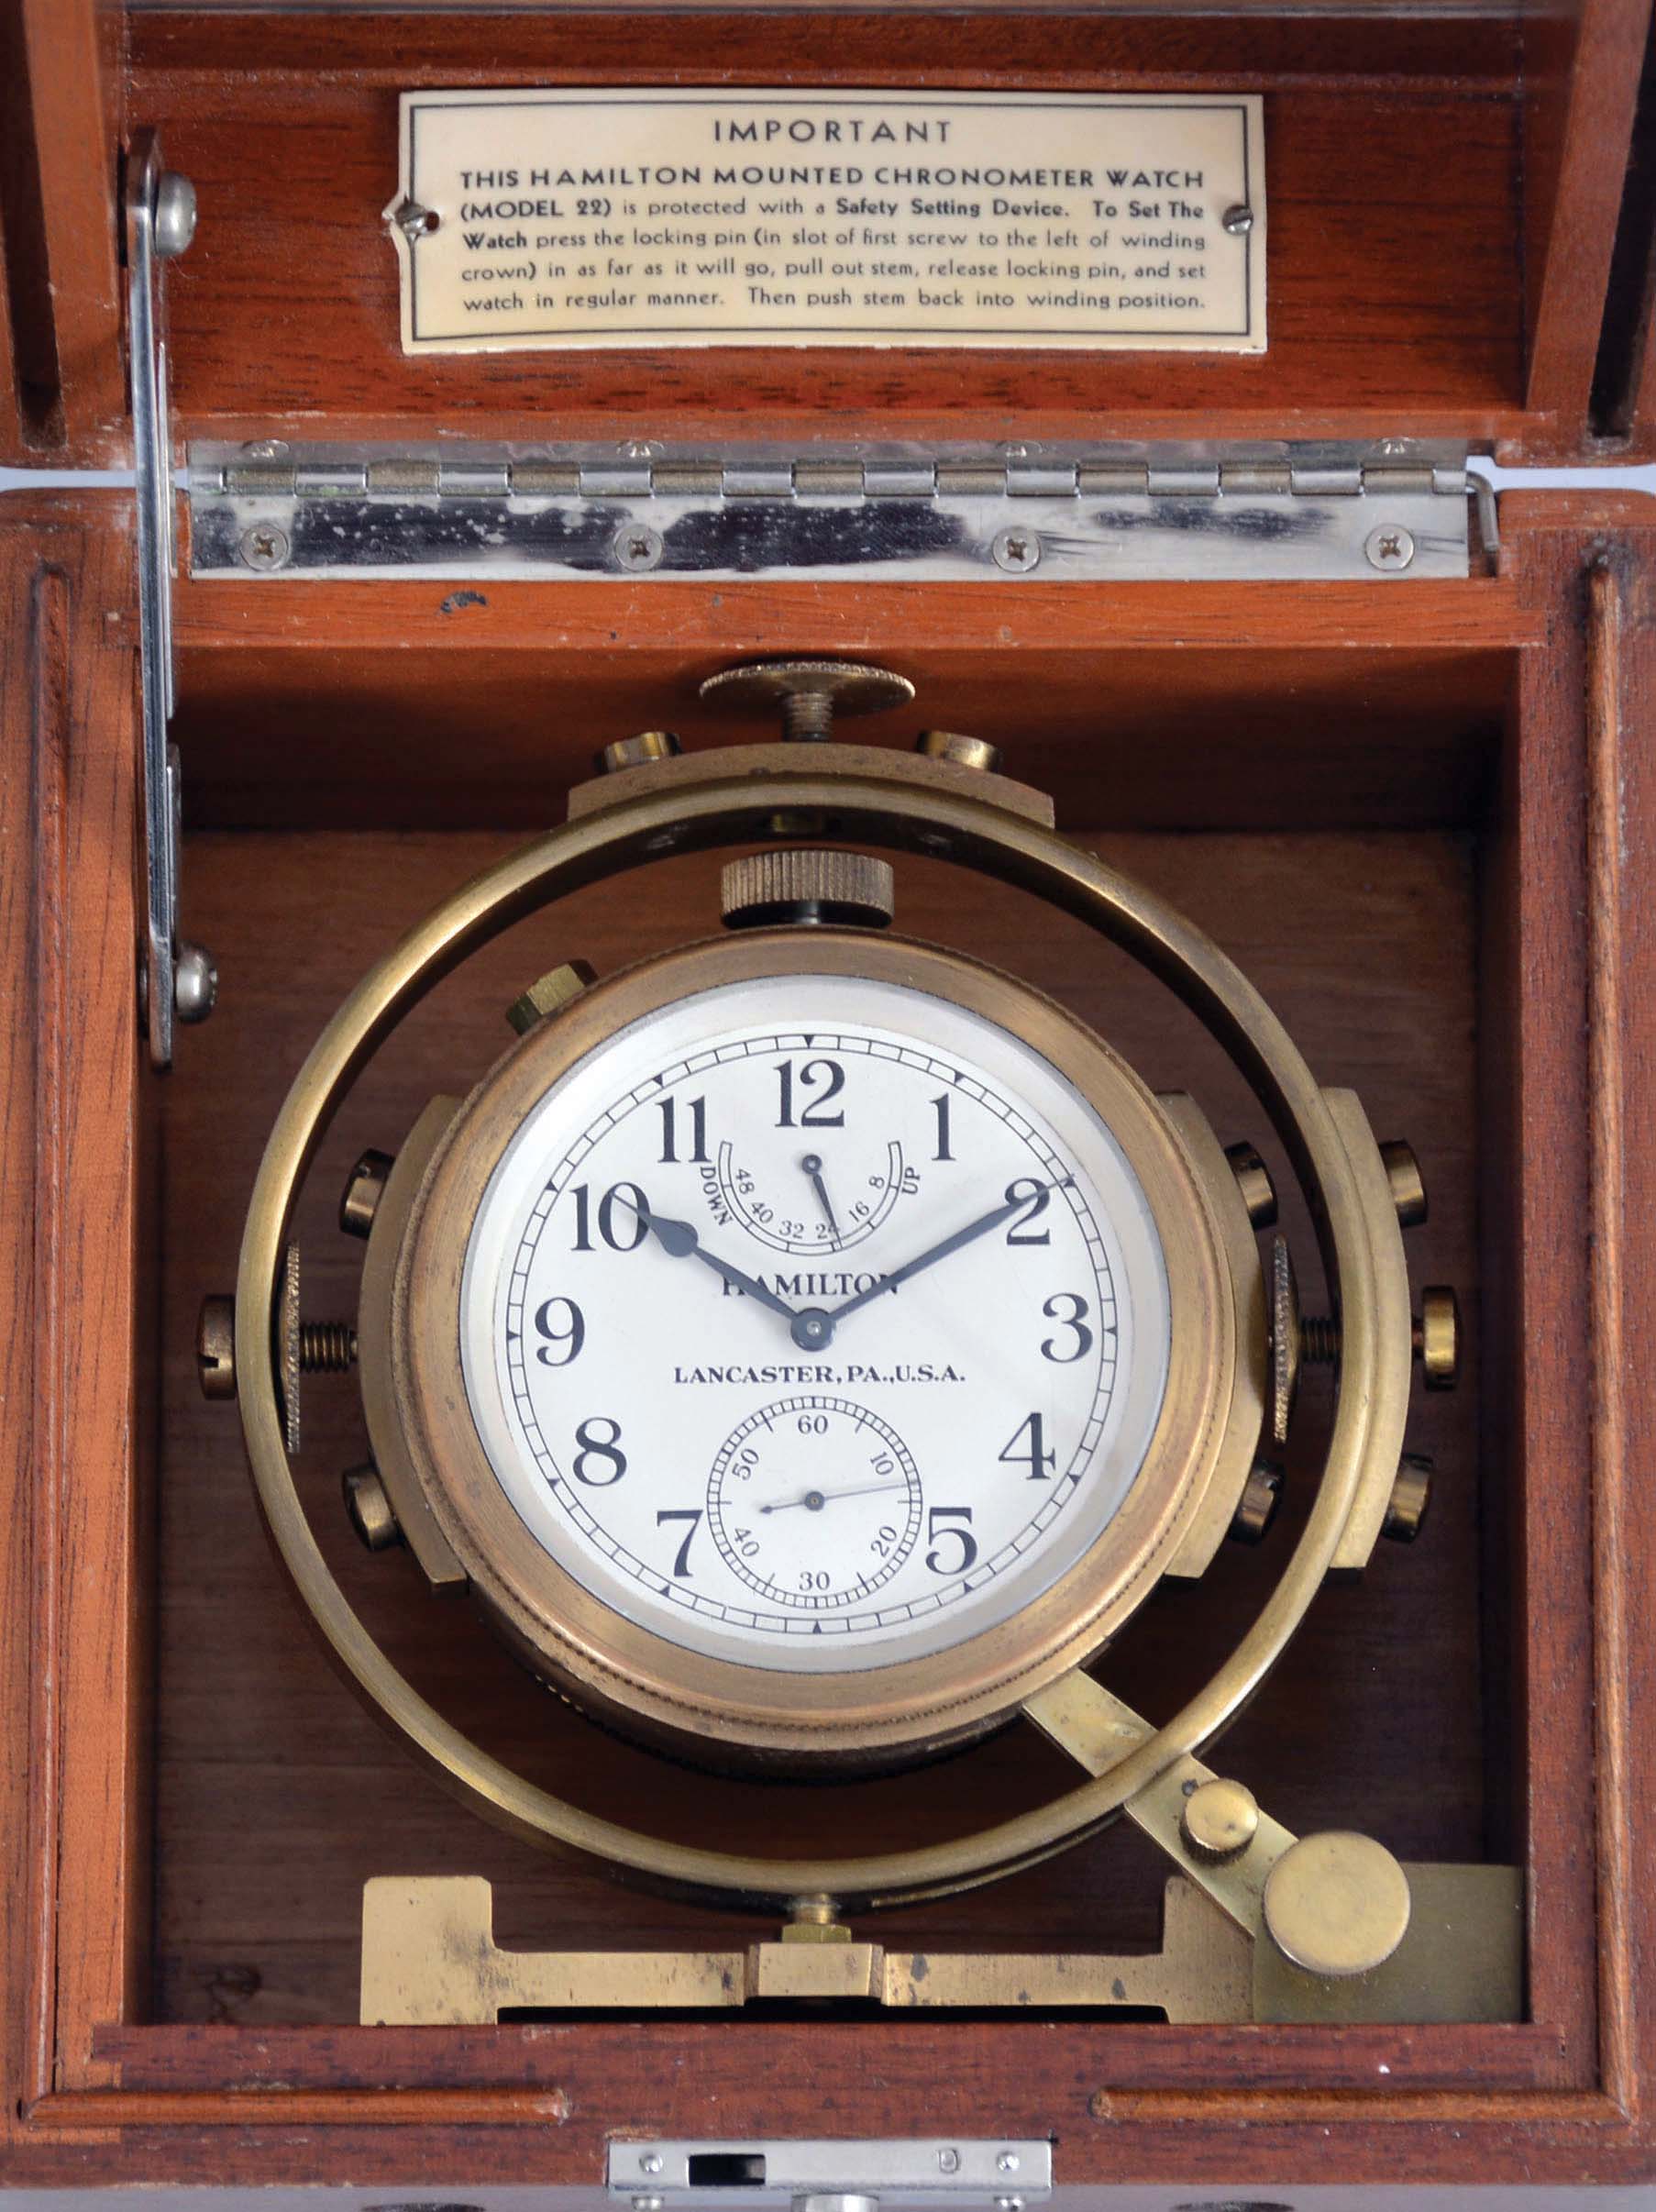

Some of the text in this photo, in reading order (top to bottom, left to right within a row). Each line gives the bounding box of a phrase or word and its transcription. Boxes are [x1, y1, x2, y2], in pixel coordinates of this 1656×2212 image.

[713, 119, 951, 143] IMPORTANT
[460, 166, 1204, 190] THIS HAMILTON MOUNTED CHRONOMETER WATCH
[460, 196, 1204, 222] (MODEL 22) is protected with a Safety Setting Device. To Set The
[462, 227, 1206, 251] Watch press the locking pin (in slot of first screw to the left of winding
[462, 256, 1206, 282] crown) in as far as it will go, pull out stem, release locking pin, and set
[463, 285, 1205, 312] watch in regular manner. Then push stem back into winding position.
[774, 1058, 845, 1128] 12
[655, 1095, 712, 1164] 11
[930, 1092, 955, 1162] 1
[735, 1168, 755, 1195] 48
[868, 1176, 885, 1189] 8
[901, 1167, 921, 1195] UP
[700, 1166, 734, 1226] DOWN
[569, 1181, 651, 1253] 10
[751, 1201, 774, 1224] 40
[848, 1200, 870, 1222] 16
[1004, 1178, 1051, 1245] 2
[778, 1220, 804, 1240] 32
[534, 1296, 586, 1367] 9
[1041, 1292, 1094, 1364] 3
[797, 1414, 830, 1435] 60
[572, 1417, 628, 1488] 8
[998, 1412, 1056, 1481] 4
[732, 1448, 760, 1481] 50
[869, 1451, 895, 1477] 10
[655, 1509, 704, 1579] 7
[733, 1527, 760, 1558] 40
[870, 1525, 899, 1558] 20
[924, 1506, 978, 1576] 5
[799, 1571, 832, 1592] 30
